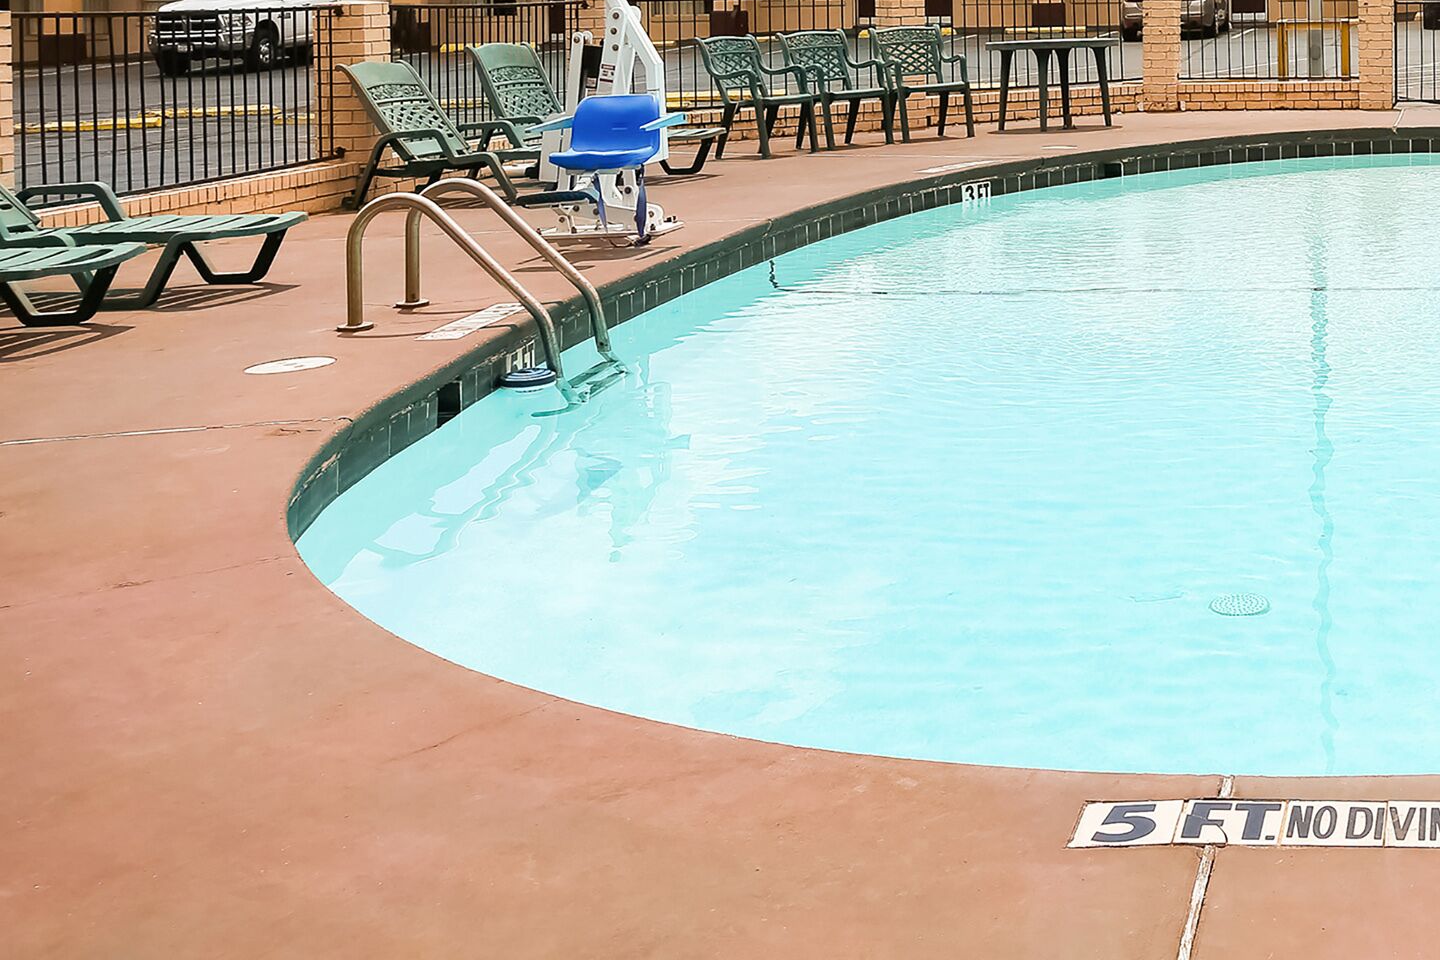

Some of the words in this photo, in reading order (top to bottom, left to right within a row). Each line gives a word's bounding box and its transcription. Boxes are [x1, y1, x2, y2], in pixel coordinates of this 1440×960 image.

[965, 185, 975, 201] 3
[977, 183, 989, 199] FT
[1091, 804, 1157, 843] 5
[1181, 803, 1282, 840] FT.
[1286, 805, 1338, 840] NO
